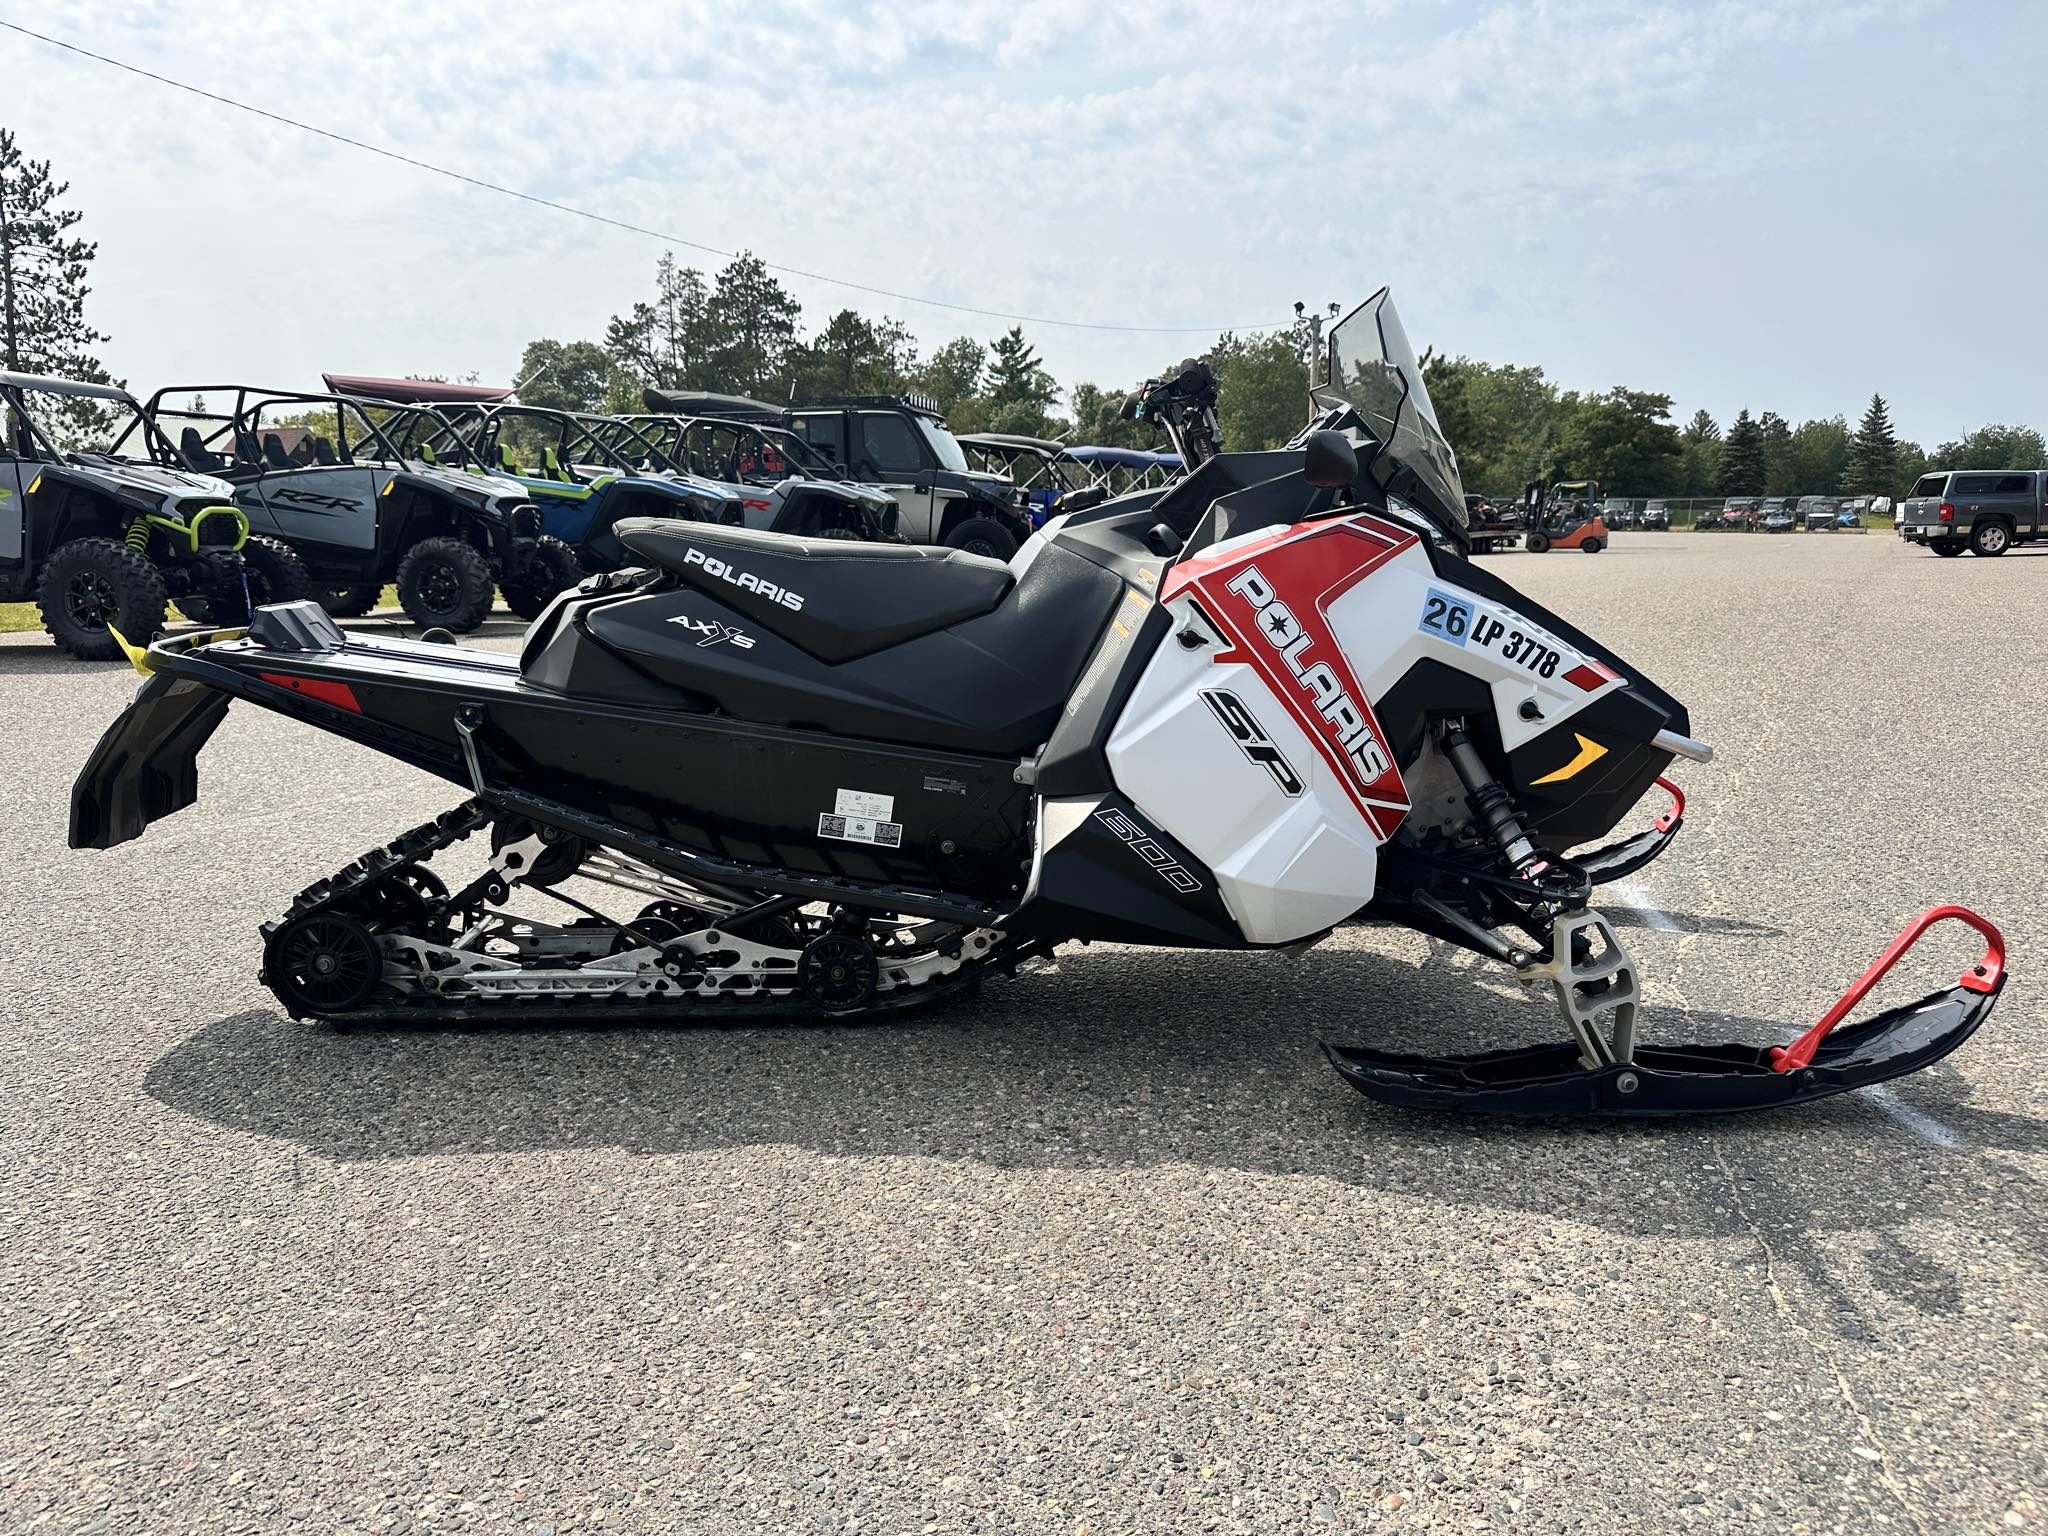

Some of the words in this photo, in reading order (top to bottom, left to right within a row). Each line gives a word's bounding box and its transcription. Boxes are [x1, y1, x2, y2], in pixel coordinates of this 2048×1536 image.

[270, 488, 365, 513] RZR
[683, 548, 805, 612] POLARIS
[1423, 597, 1468, 637] 26
[1470, 614, 1505, 648] LP
[1502, 630, 1561, 679] 3778
[1225, 564, 1390, 785] POLARIS
[1198, 688, 1306, 798] SP
[1094, 808, 1202, 893] 500
